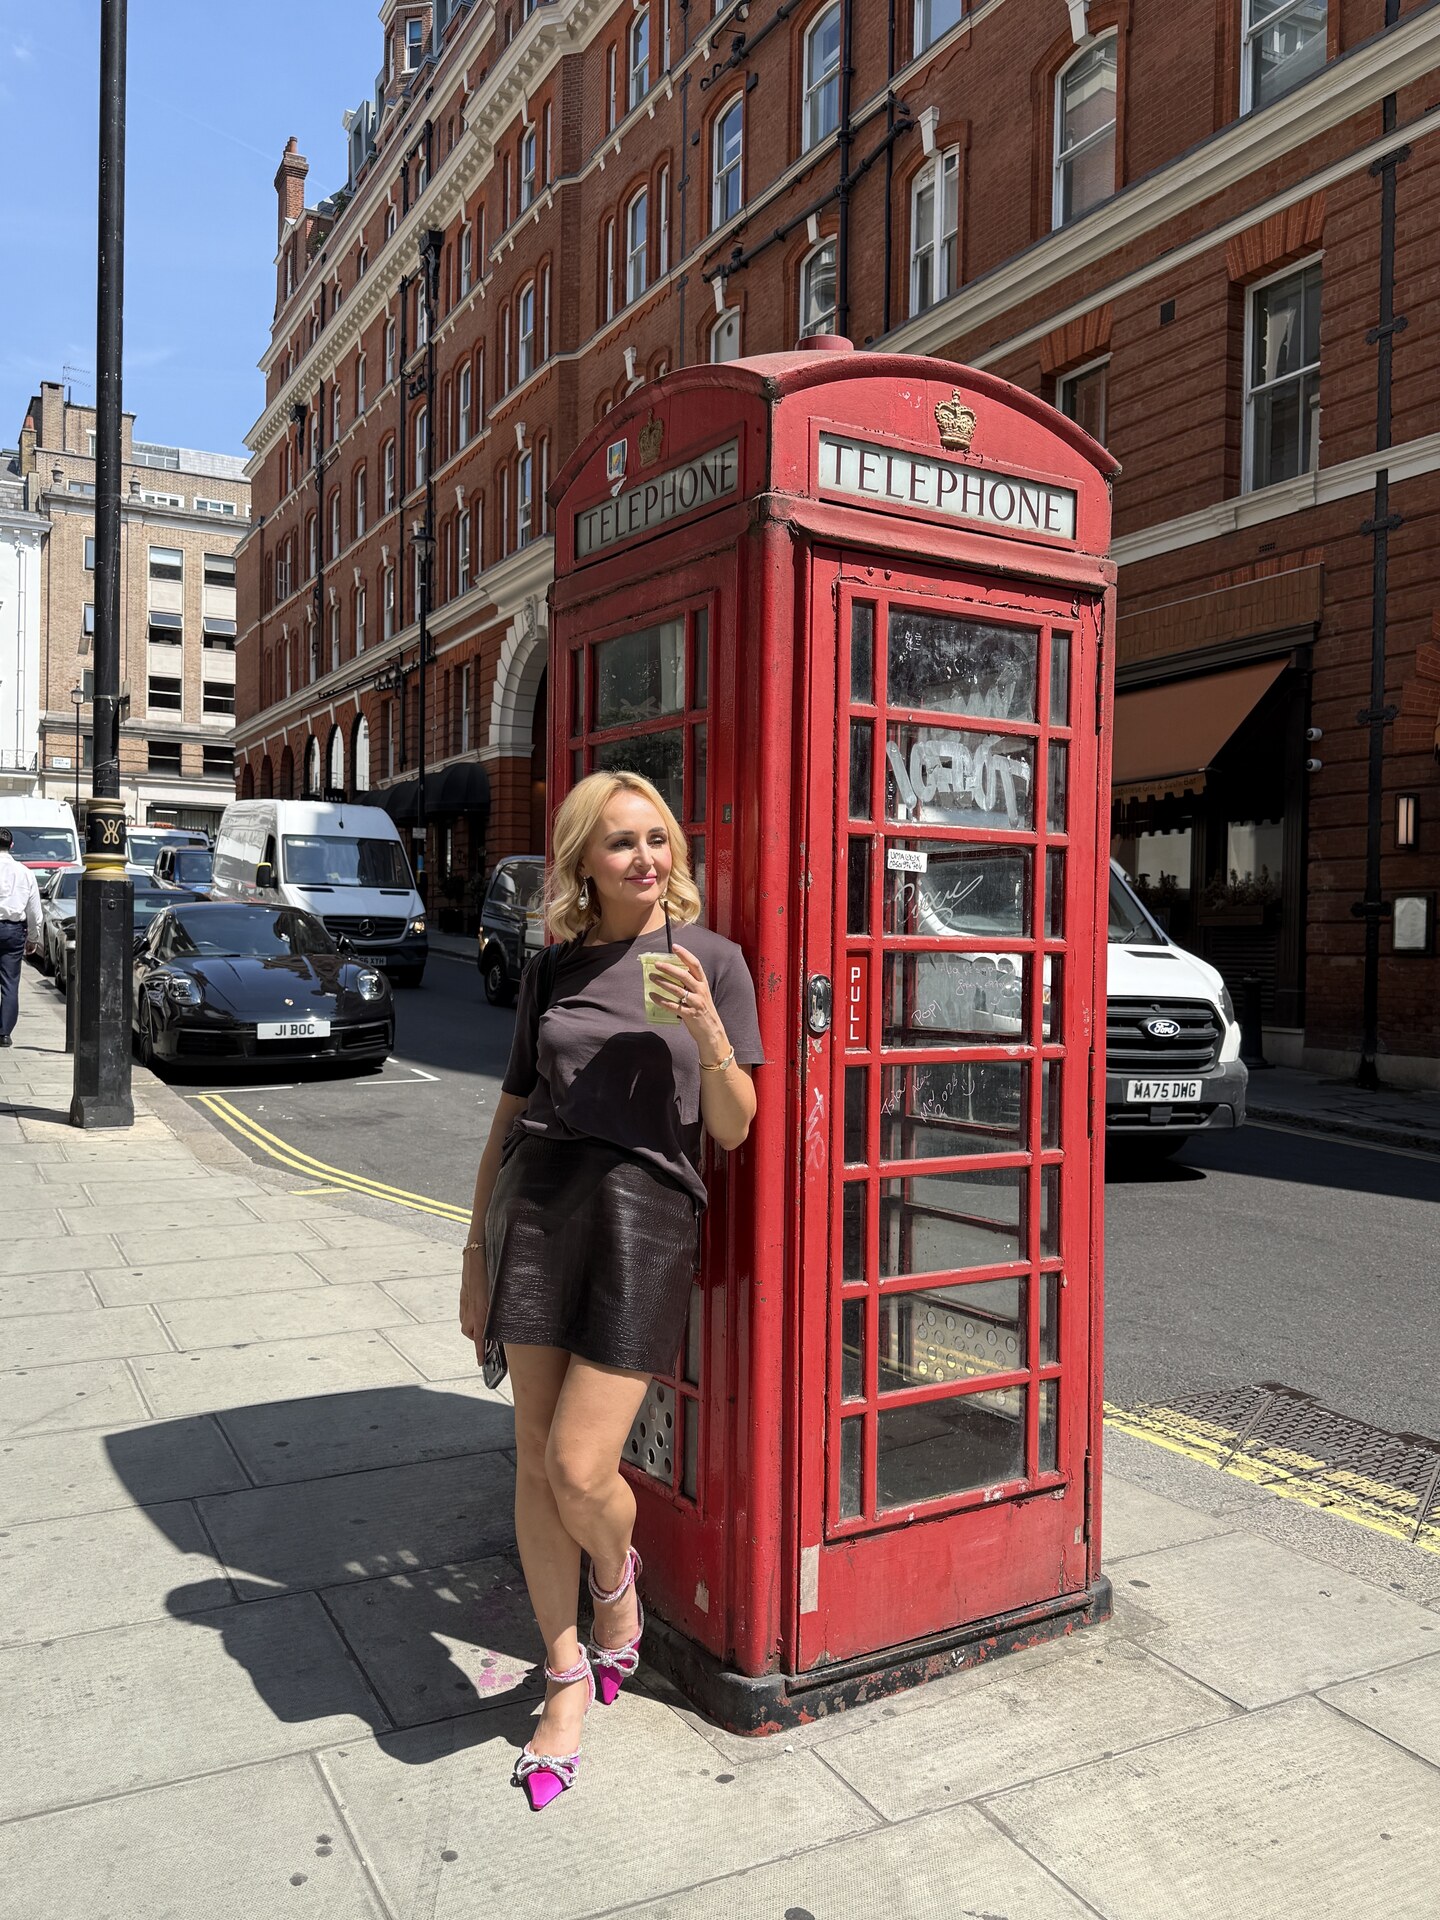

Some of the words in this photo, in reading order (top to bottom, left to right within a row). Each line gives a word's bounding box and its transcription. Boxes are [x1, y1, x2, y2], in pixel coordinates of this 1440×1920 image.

[583, 447, 735, 550] TELEPHONE
[824, 442, 1063, 532] TELEPHONE
[849, 967, 861, 1040] PULL
[290, 1023, 315, 1036] BOC
[1153, 1021, 1176, 1034] Ford
[1134, 1083, 1170, 1099] MA75
[1171, 1082, 1197, 1098] DWG
